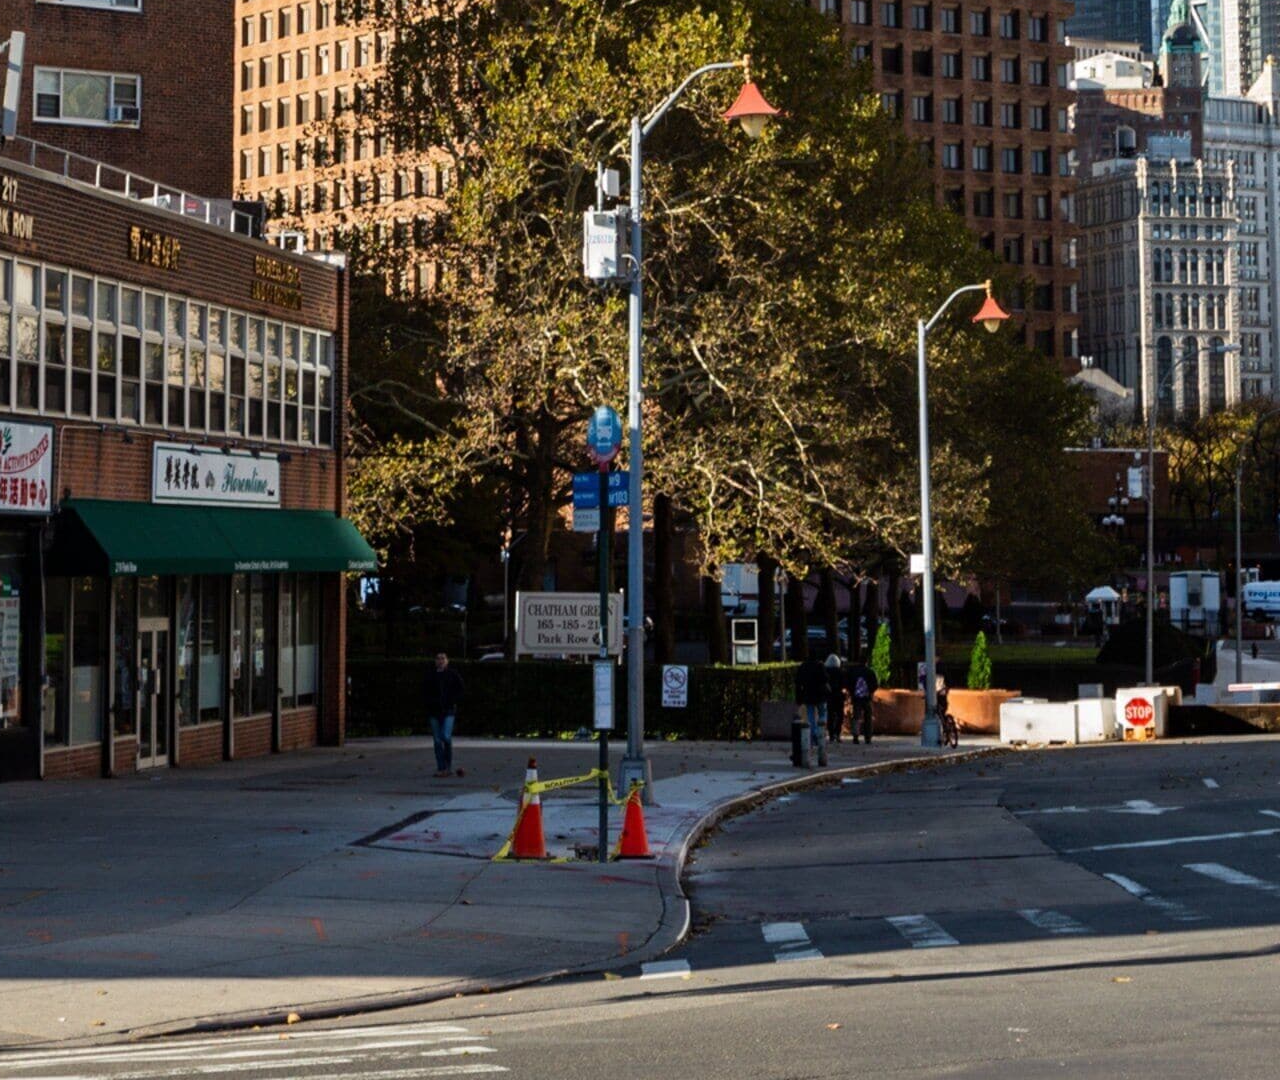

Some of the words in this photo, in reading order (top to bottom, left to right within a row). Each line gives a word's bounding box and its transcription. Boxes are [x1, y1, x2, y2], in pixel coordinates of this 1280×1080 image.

[1, 176, 18, 204] 217
[11, 212, 34, 240] ROW
[221, 461, 269, 494] Florentine
[527, 603, 578, 617] CHATHAM
[580, 604, 614, 617] GREN
[537, 632, 562, 644] Park
[567, 633, 589, 644] Row
[1126, 706, 1152, 720] STOP
